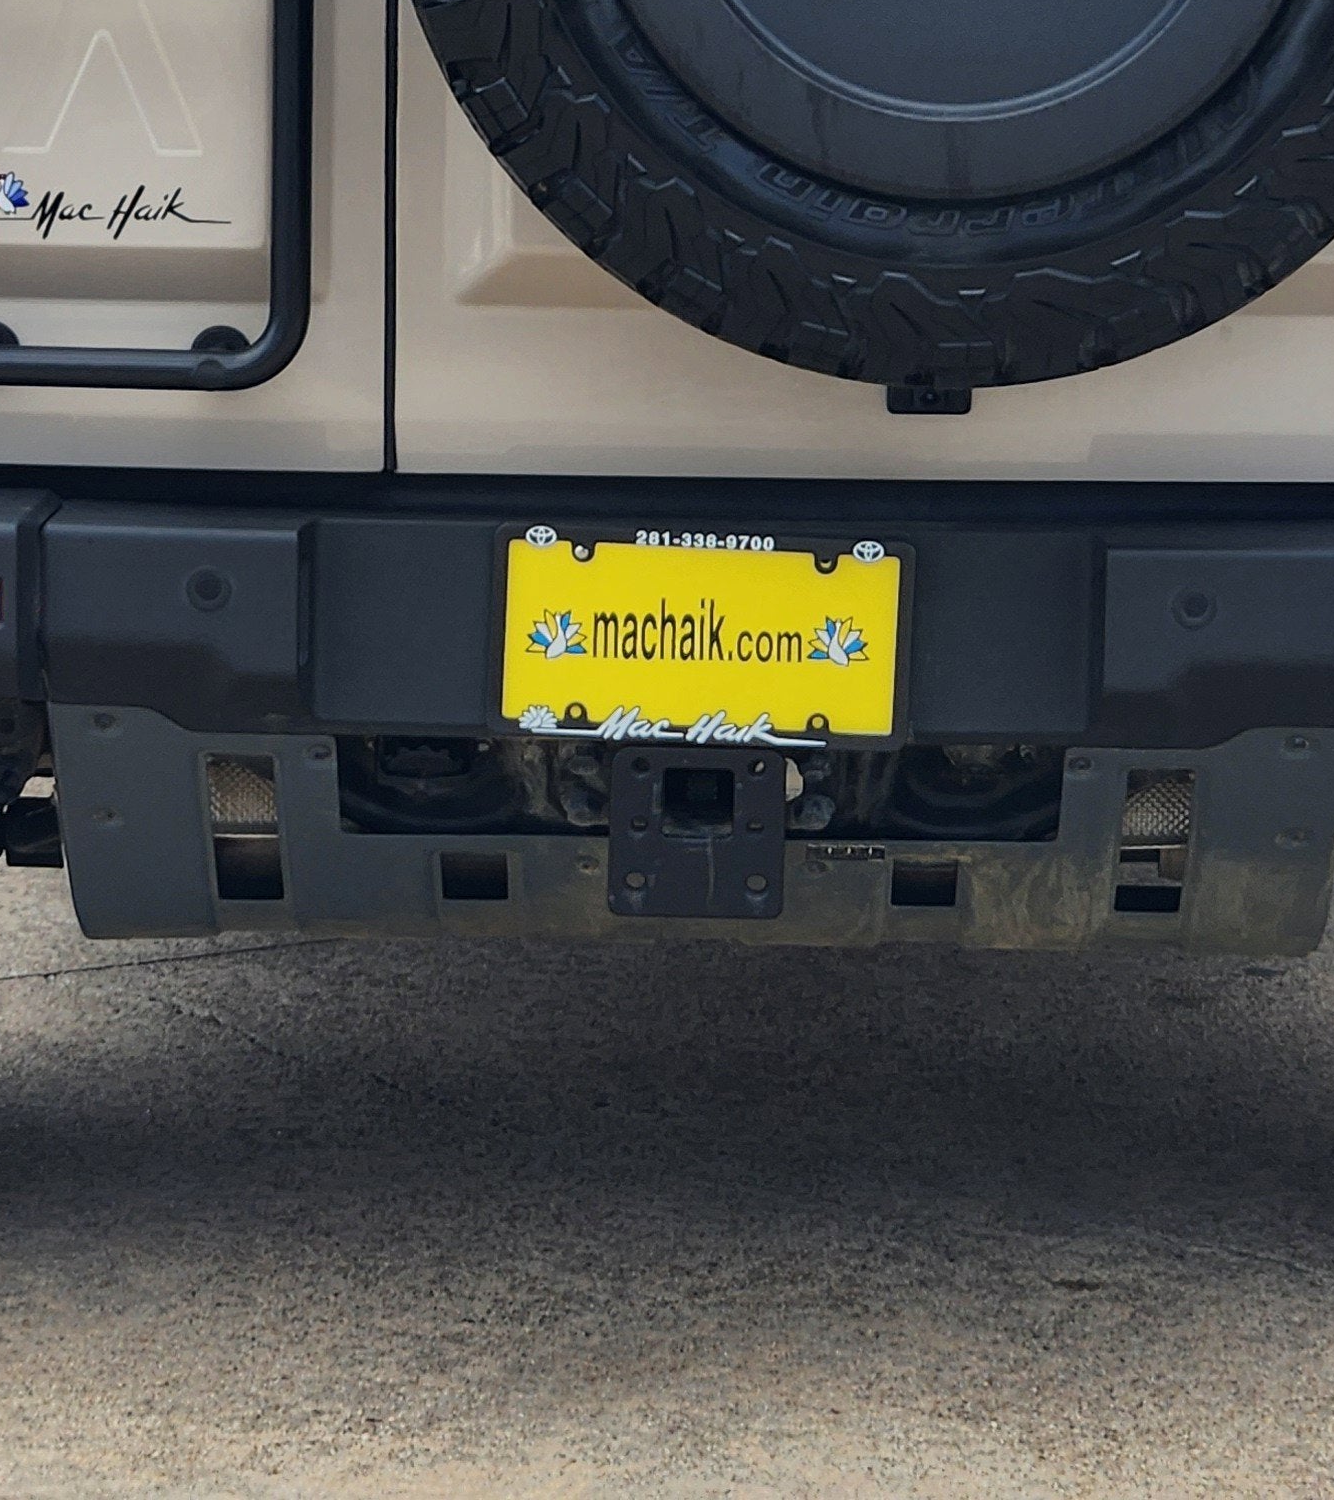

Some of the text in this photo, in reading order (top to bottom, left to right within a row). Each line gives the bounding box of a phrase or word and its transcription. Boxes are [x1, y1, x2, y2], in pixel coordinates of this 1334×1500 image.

[31, 185, 199, 239] Mac Haik
[634, 529, 776, 551] 281-338-9700
[592, 597, 803, 664] machaik.com
[597, 705, 783, 745] Mac Haik
